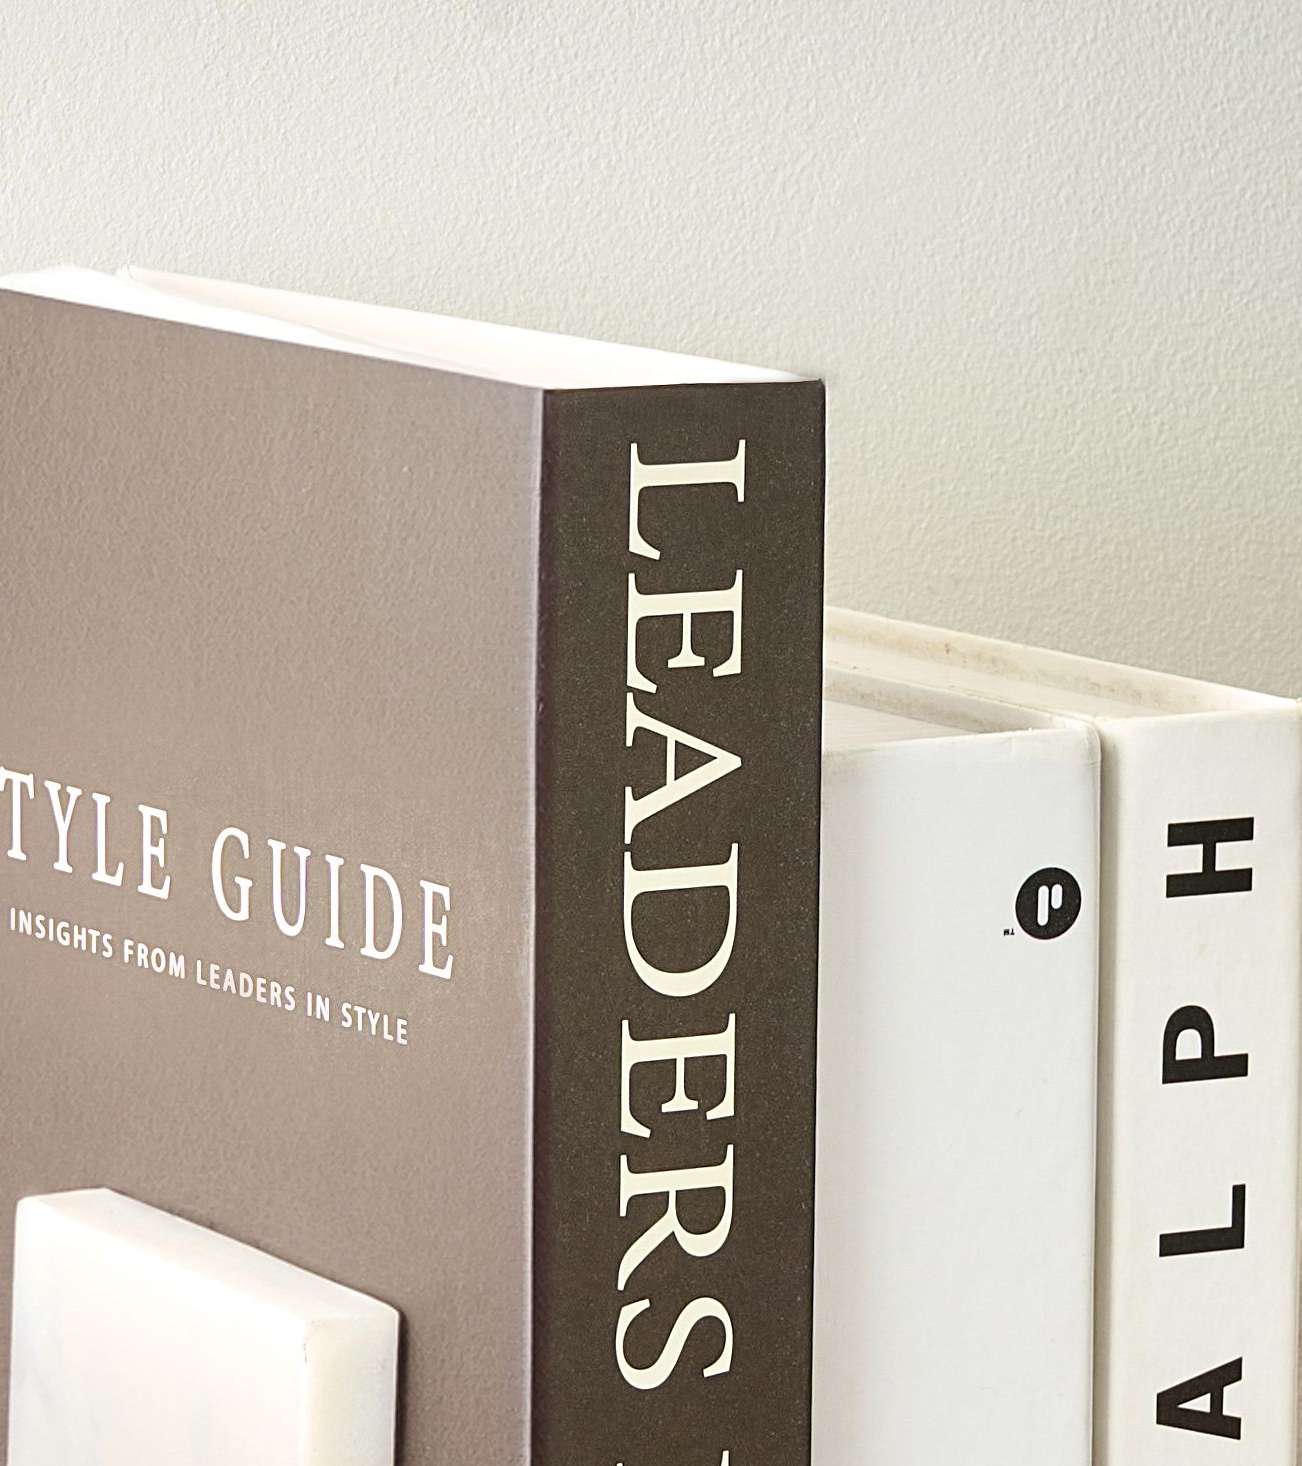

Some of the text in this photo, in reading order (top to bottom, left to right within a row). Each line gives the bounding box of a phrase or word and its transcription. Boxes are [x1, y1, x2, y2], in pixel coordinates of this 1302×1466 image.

[9, 906, 408, 1046] INSIGHTS FROM LEADERS IN STYLE
[211, 826, 454, 980] GUIDE
[615, 439, 746, 1390] LEADERS
